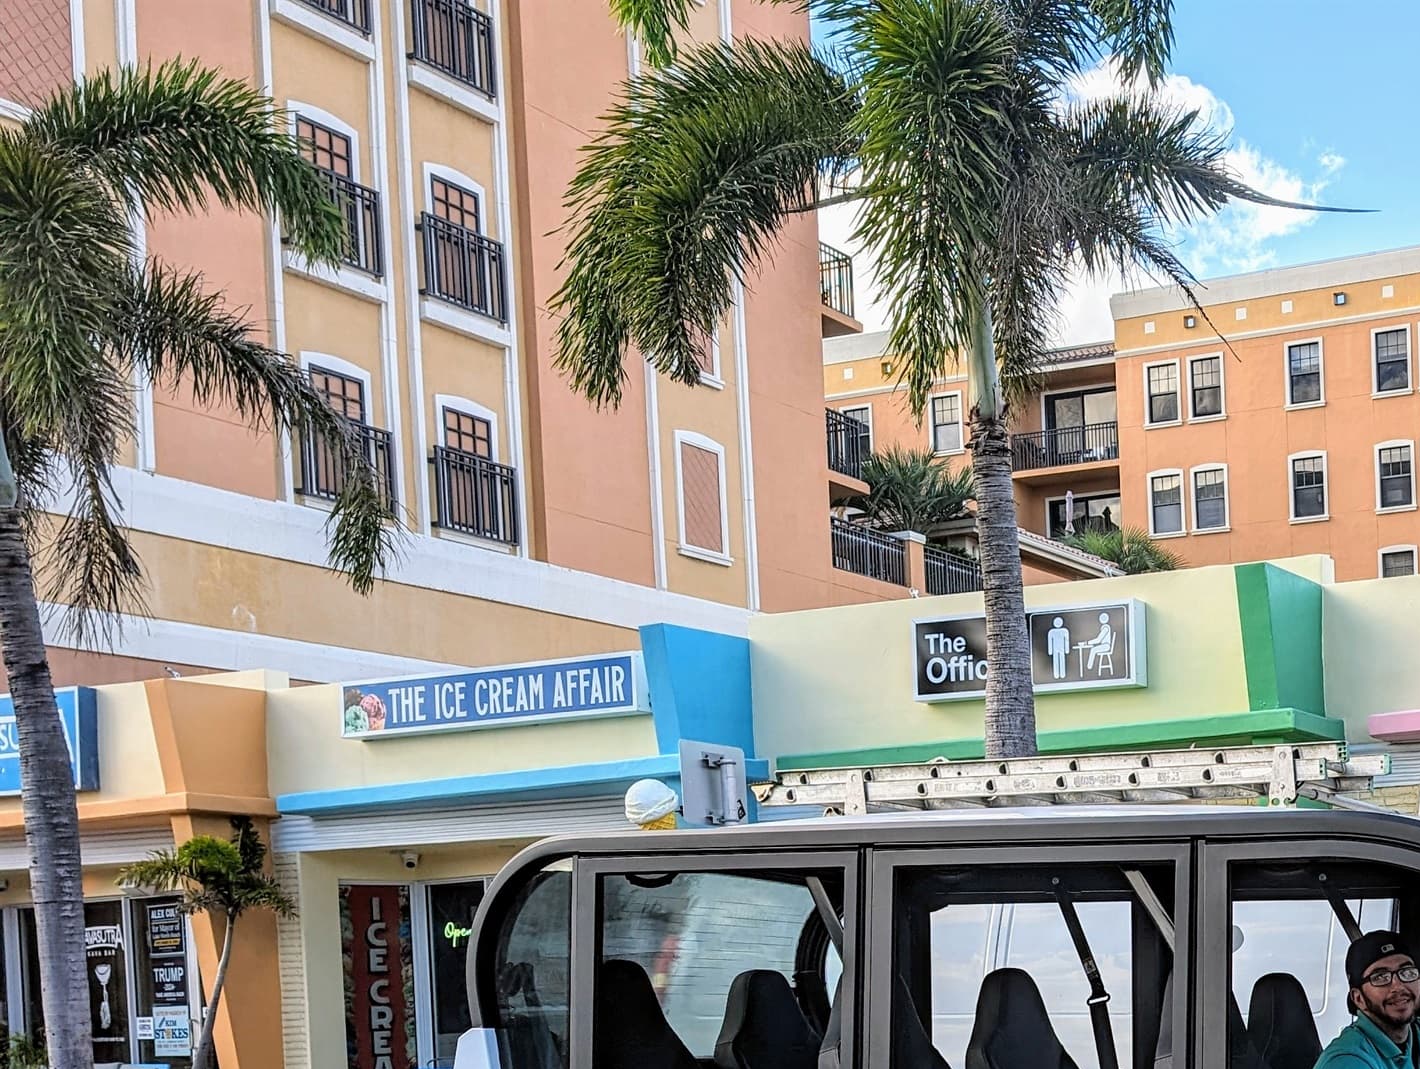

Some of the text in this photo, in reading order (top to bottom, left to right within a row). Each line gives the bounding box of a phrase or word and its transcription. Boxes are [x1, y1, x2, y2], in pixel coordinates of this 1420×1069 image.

[924, 632, 967, 655] The
[926, 655, 988, 684] Offic
[388, 665, 625, 724] THE ICE CREAM AFFAIR
[85, 923, 125, 950] AVASUTRA
[366, 896, 387, 973] ICE
[444, 921, 473, 948] Ope
[153, 967, 184, 982] TRUMP
